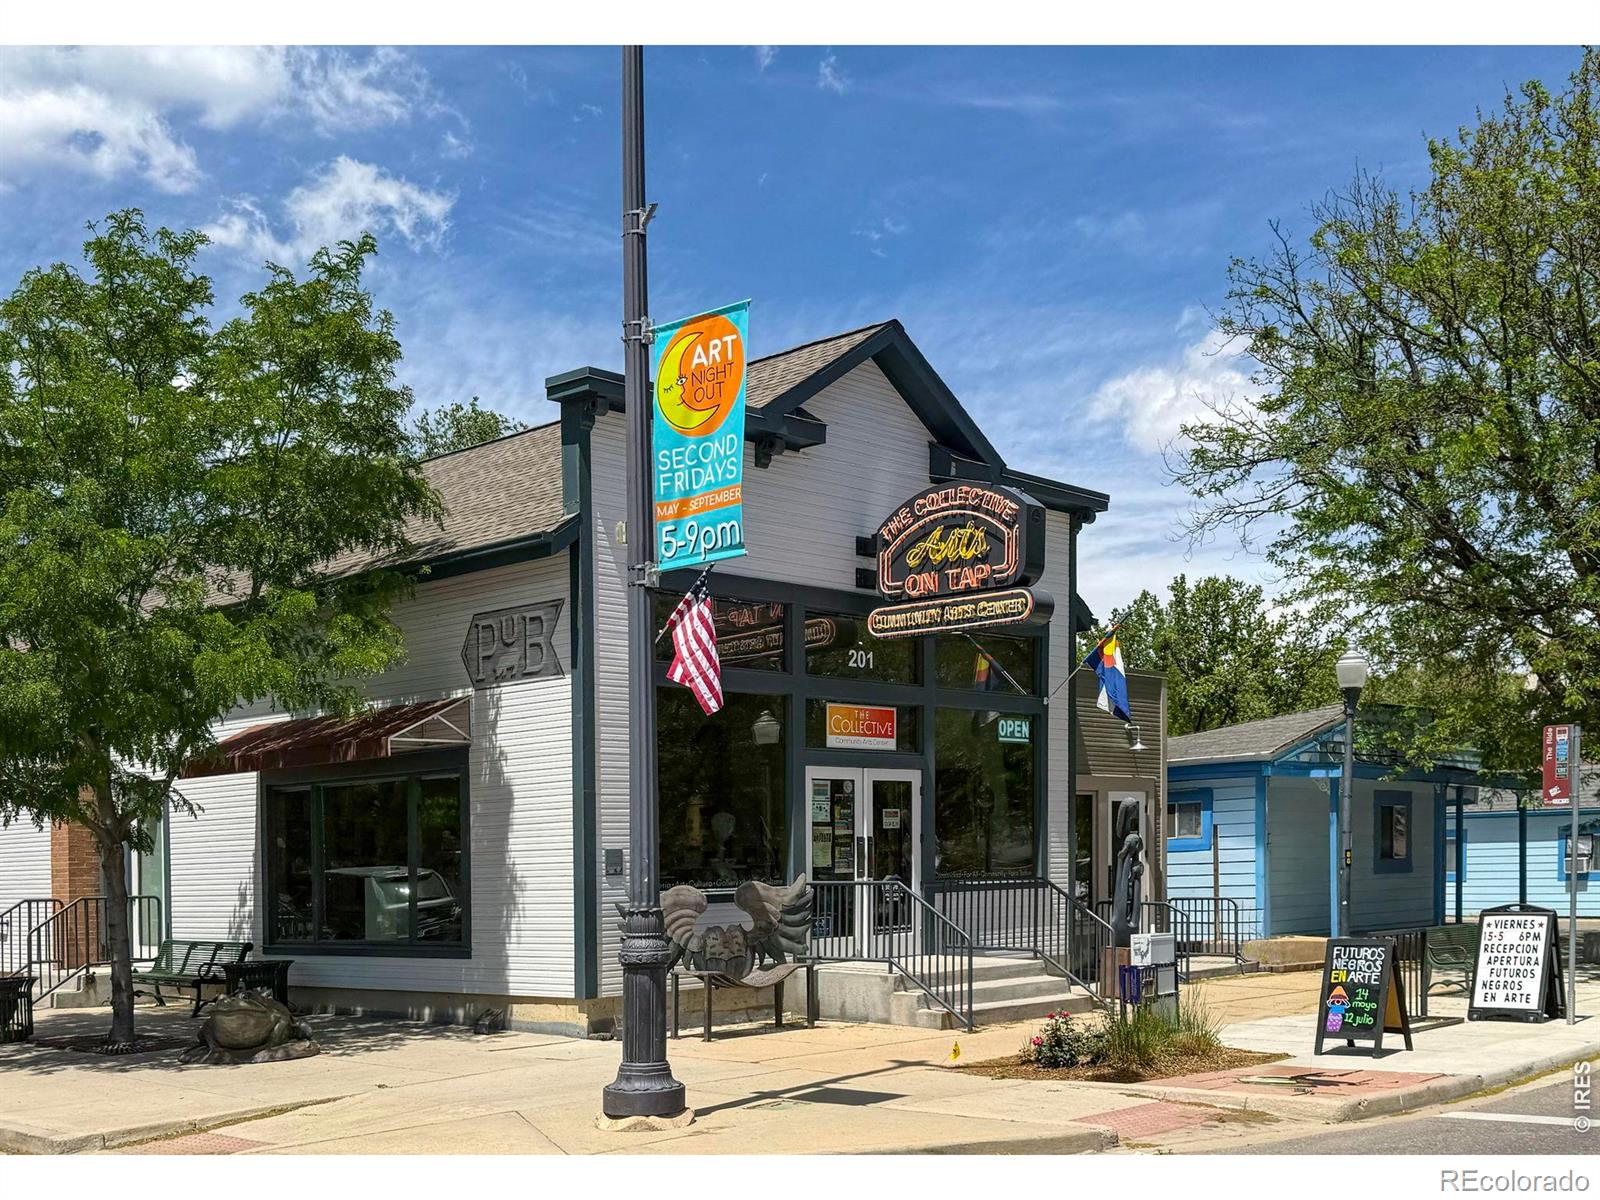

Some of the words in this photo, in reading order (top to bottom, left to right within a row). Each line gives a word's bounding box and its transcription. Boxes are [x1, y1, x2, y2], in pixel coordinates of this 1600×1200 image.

[691, 334, 738, 369] ART
[691, 361, 735, 387] NIGHT
[693, 380, 725, 403] OUT
[658, 434, 738, 470] SECOND
[660, 457, 737, 495] FRIDAYS
[656, 502, 680, 517] MAY
[689, 488, 742, 511] SEPTEMBER
[879, 507, 914, 543] THE
[914, 486, 1020, 523] COLLECTIVE
[660, 519, 742, 560] 5-9pm
[904, 571, 940, 596] ON
[945, 563, 992, 591] TAP
[943, 603, 976, 620] ARTS
[976, 597, 1026, 618] CENTER
[848, 649, 874, 669] 201
[854, 709, 870, 720] THE
[998, 719, 1030, 738] OPEN
[1545, 727, 1553, 745] Ride
[1545, 746, 1553, 761] The
[1494, 919, 1536, 930] VIERNES
[1483, 931, 1504, 942] 15-5
[1518, 931, 1541, 942] 6PM
[1332, 946, 1386, 961] FUTUROS
[1483, 943, 1539, 954] RECEPCION
[1332, 958, 1383, 973] NEGROS
[1486, 955, 1540, 967] APERTURA
[1330, 970, 1349, 983] EN
[1347, 971, 1381, 985] ARTE
[1489, 967, 1536, 979] FUTUROS
[1481, 980, 1523, 991] NEGROS
[1355, 988, 1369, 1000] 14
[1483, 992, 1496, 1003] EN
[1504, 992, 1531, 1004] ARTE
[1344, 1012, 1353, 1023] 12
[1352, 1013, 1374, 1027] julio
